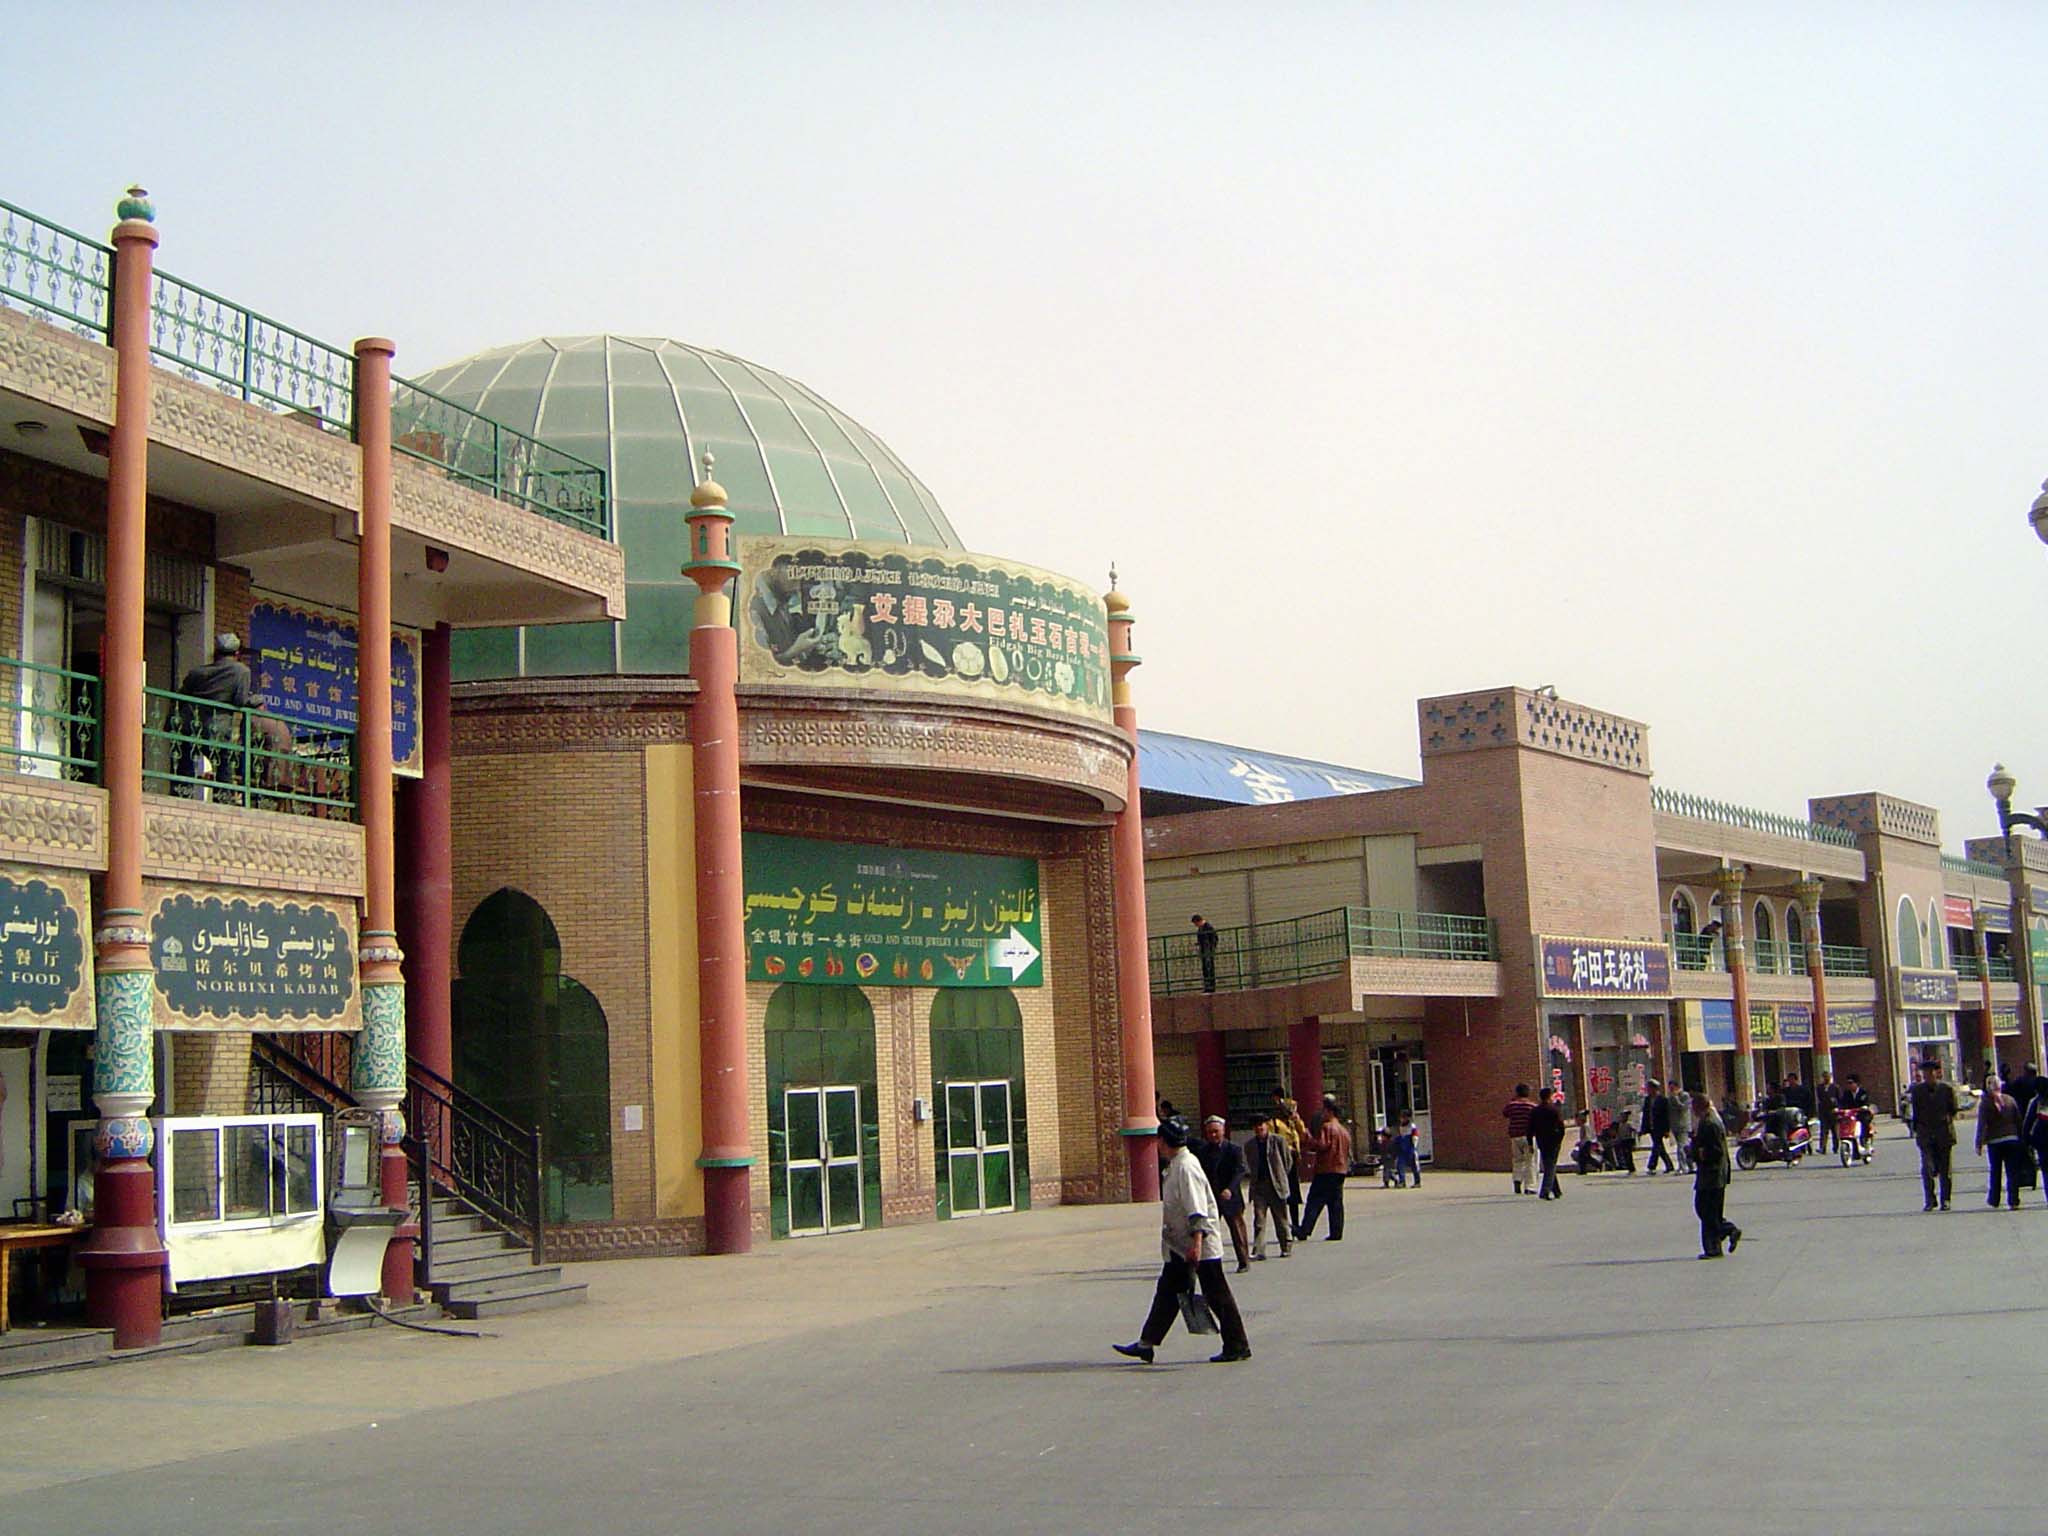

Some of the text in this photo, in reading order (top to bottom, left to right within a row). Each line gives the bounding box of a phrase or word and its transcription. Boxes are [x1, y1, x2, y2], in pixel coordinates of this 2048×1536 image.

[262, 694, 281, 706] OLD
[284, 698, 301, 711] AND
[305, 703, 332, 717] SILVER
[335, 708, 359, 722] JEWEL
[863, 933, 883, 944] GOLD
[885, 934, 900, 945] AND
[12, 971, 61, 986] FOOD
[196, 979, 340, 996] NORBIXI KABAB
